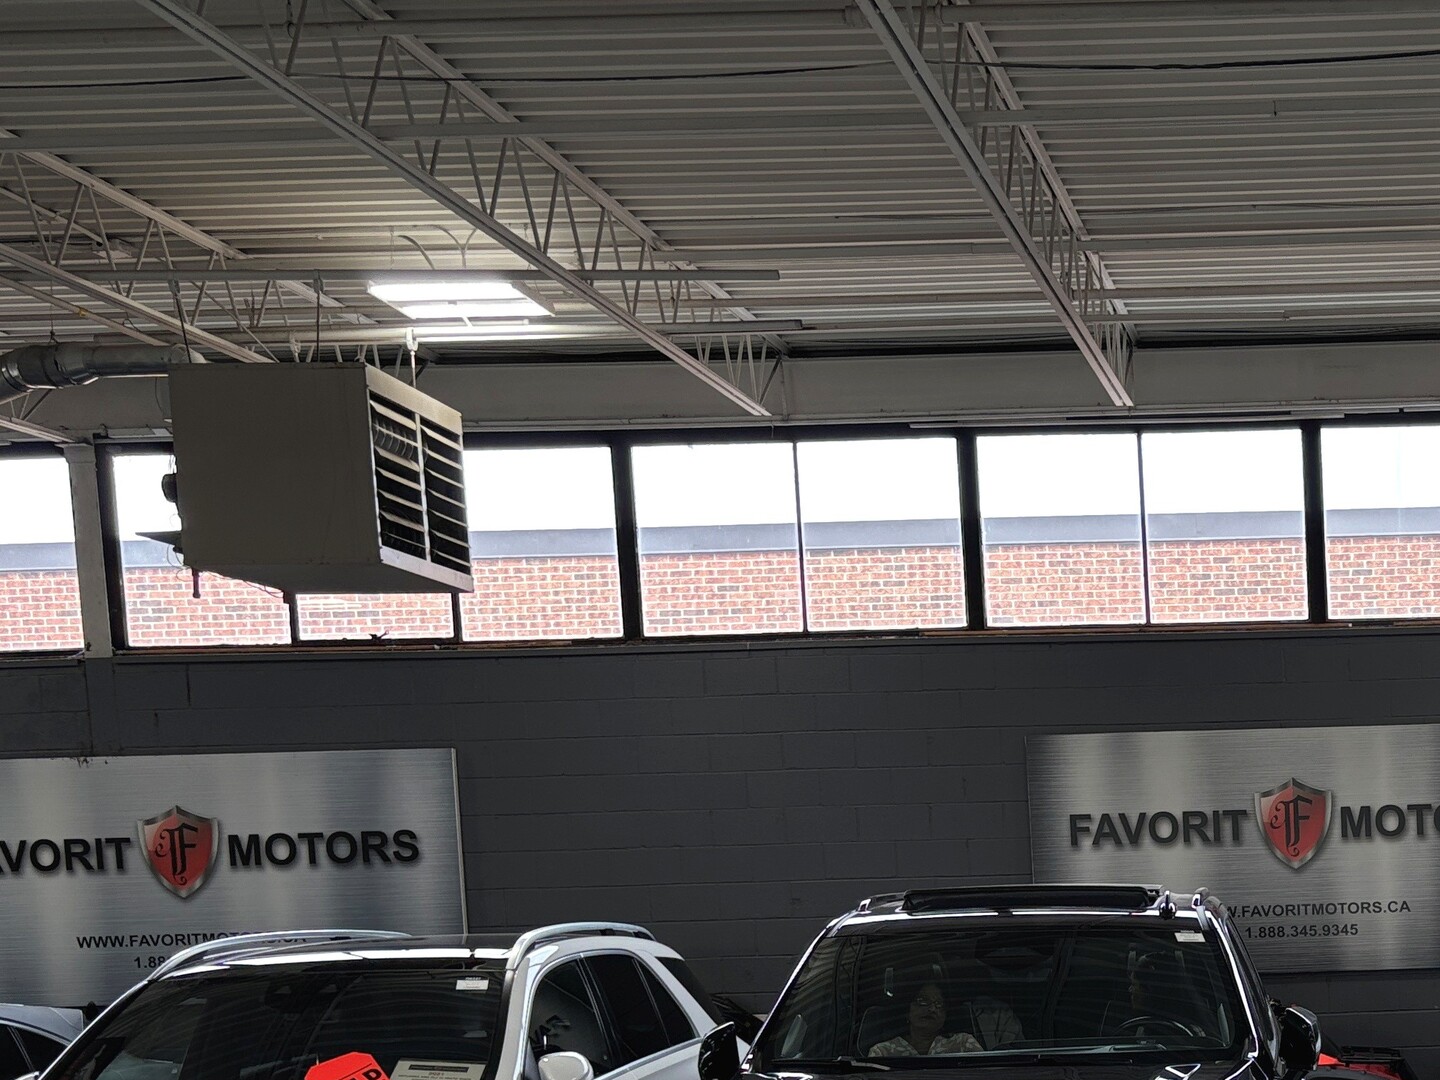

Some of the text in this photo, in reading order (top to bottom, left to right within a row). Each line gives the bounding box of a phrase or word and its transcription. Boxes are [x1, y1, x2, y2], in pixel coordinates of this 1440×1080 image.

[1069, 809, 1247, 846] FAVORIT
[0, 837, 131, 872] VORIT
[228, 829, 420, 868] MOTORS
[1227, 900, 1411, 918] W.FAVORITMOTORS.CA
[1245, 923, 1358, 939] 1.888.345.9345
